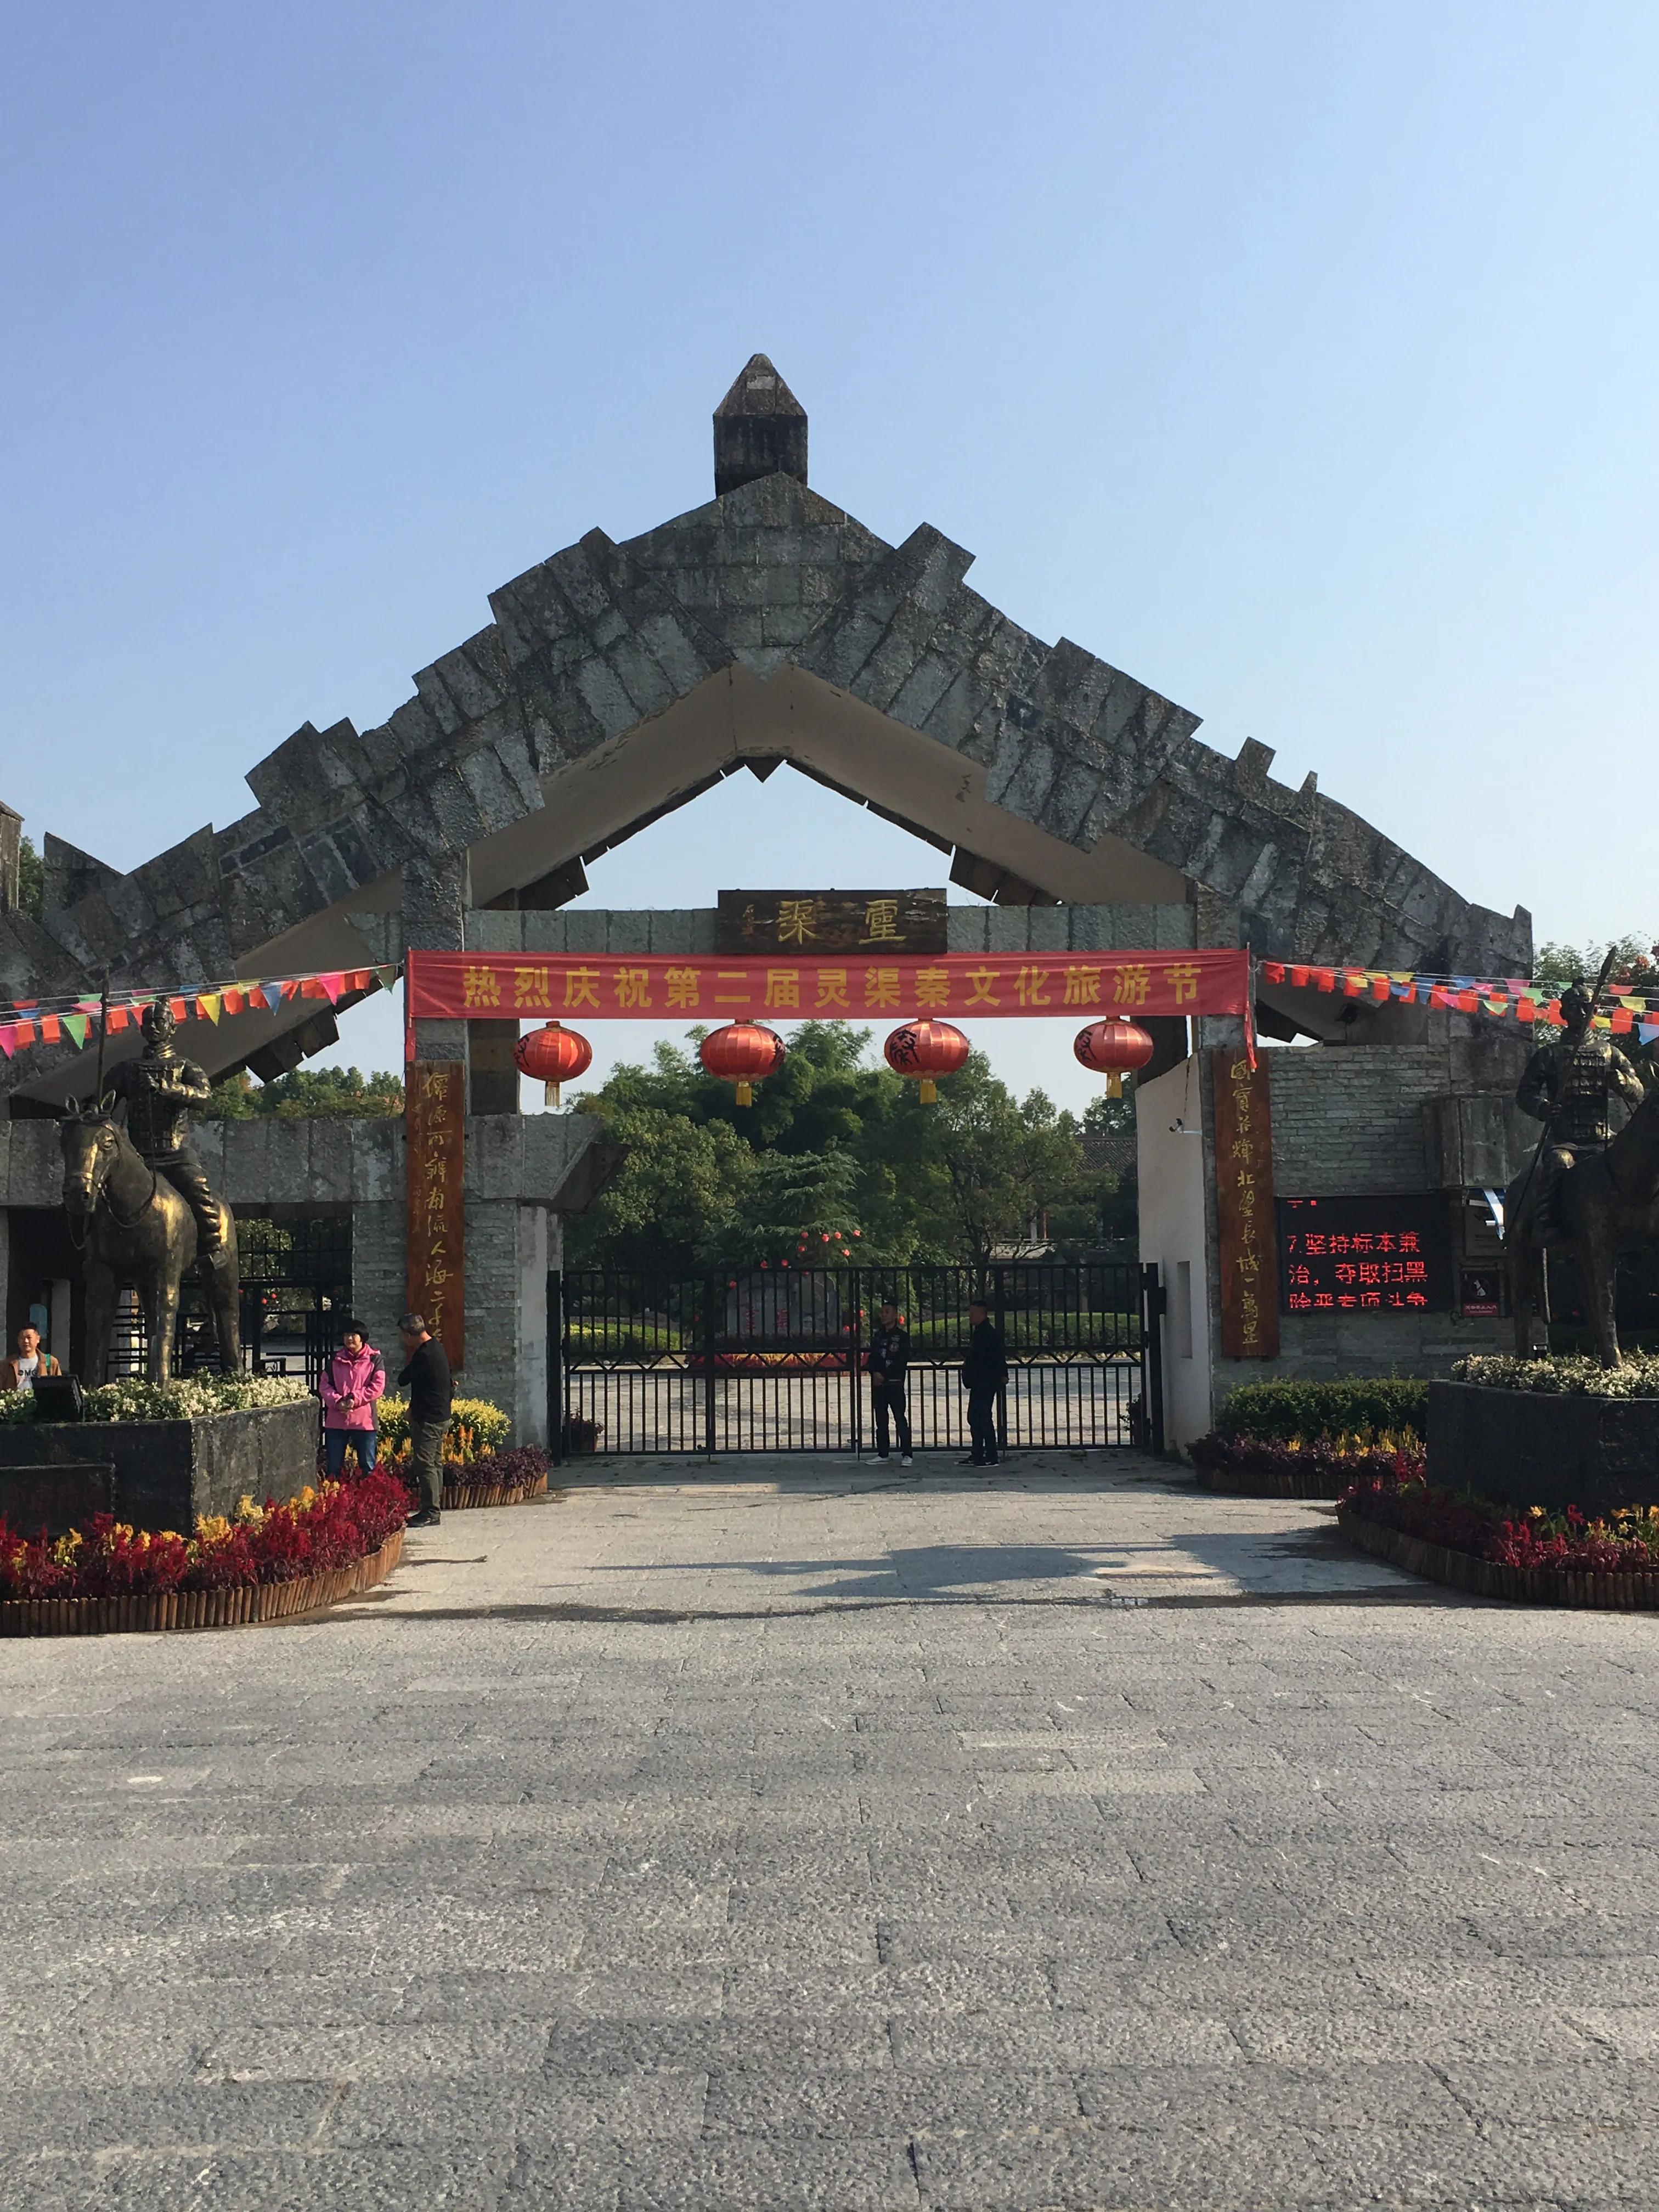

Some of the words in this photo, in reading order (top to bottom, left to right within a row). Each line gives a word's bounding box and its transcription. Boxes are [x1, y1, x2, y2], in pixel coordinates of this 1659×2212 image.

[462, 964, 1204, 1009] 热烈庆祝第二届灵渠秦文化旅游节
[1286, 1231, 1420, 1255] 7.坚持标本兼
